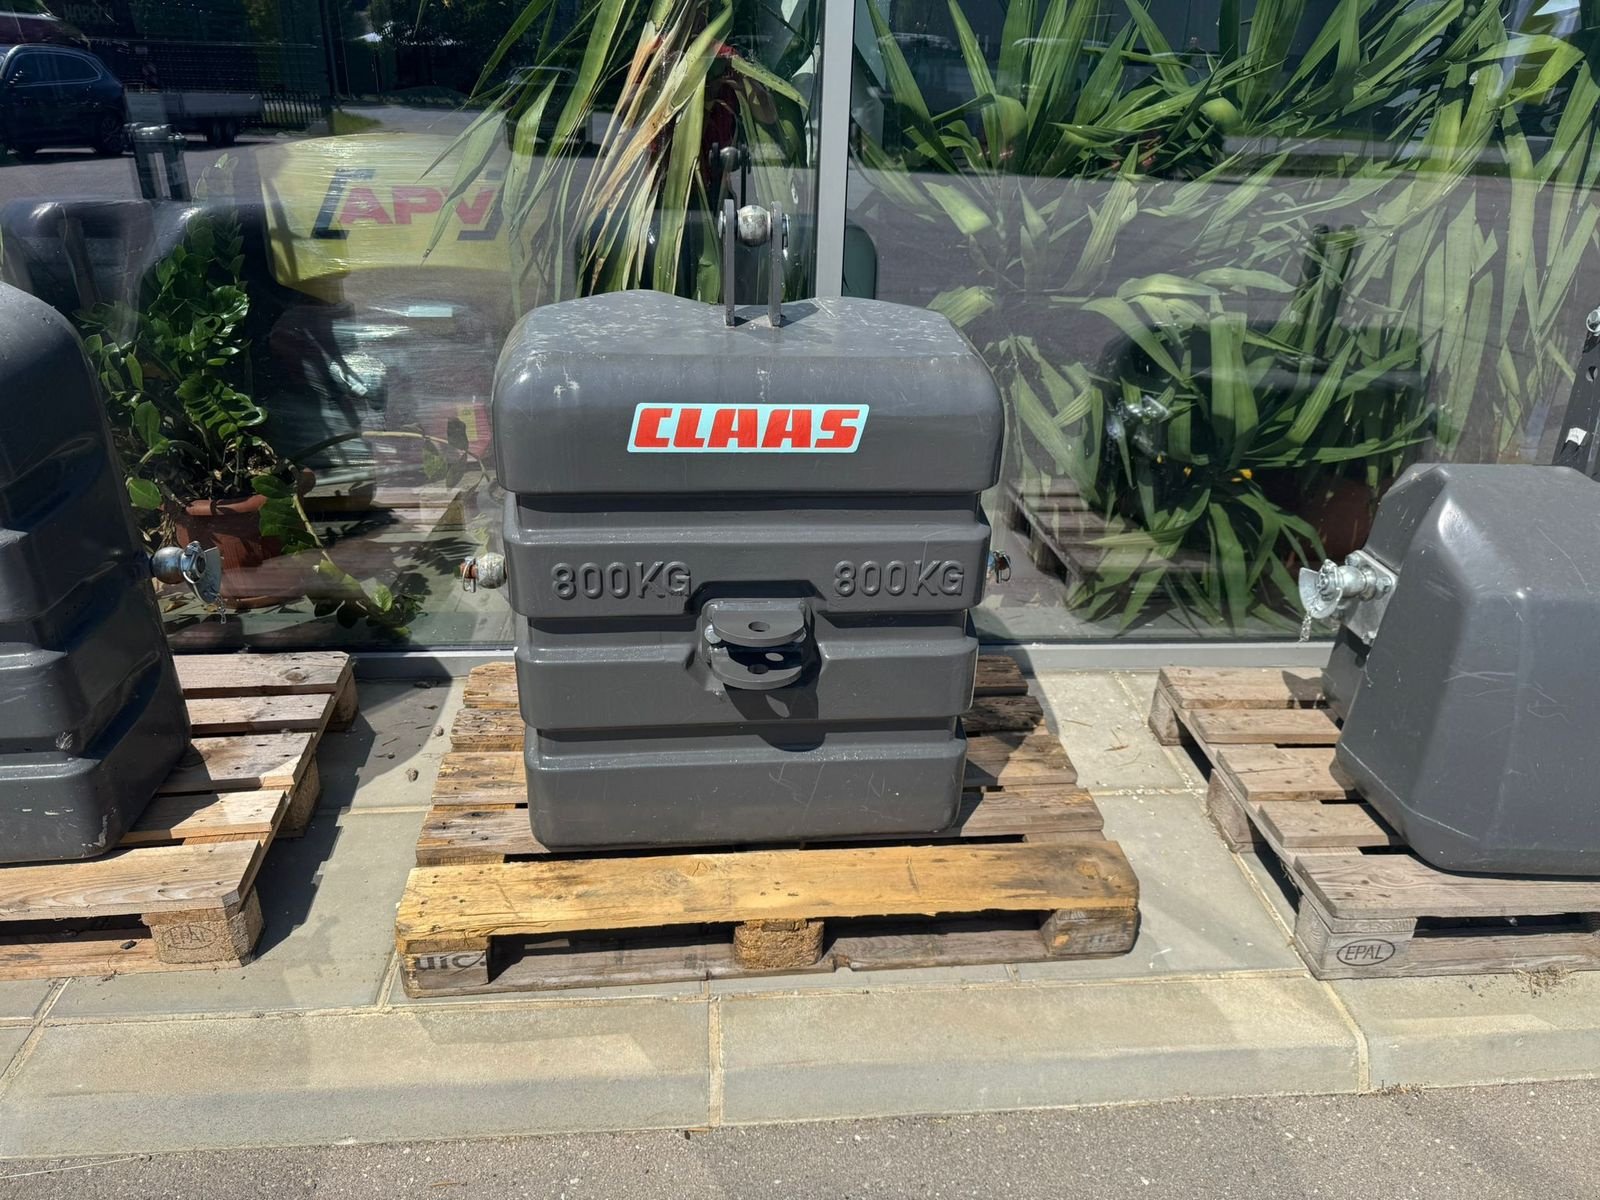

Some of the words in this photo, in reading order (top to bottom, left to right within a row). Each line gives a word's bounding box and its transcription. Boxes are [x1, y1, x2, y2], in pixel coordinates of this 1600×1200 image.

[340, 186, 496, 225] APV
[634, 408, 860, 448] CLAAS
[551, 561, 691, 600] 800KG
[834, 560, 964, 597] 800KG
[1344, 944, 1384, 960] EPAL
